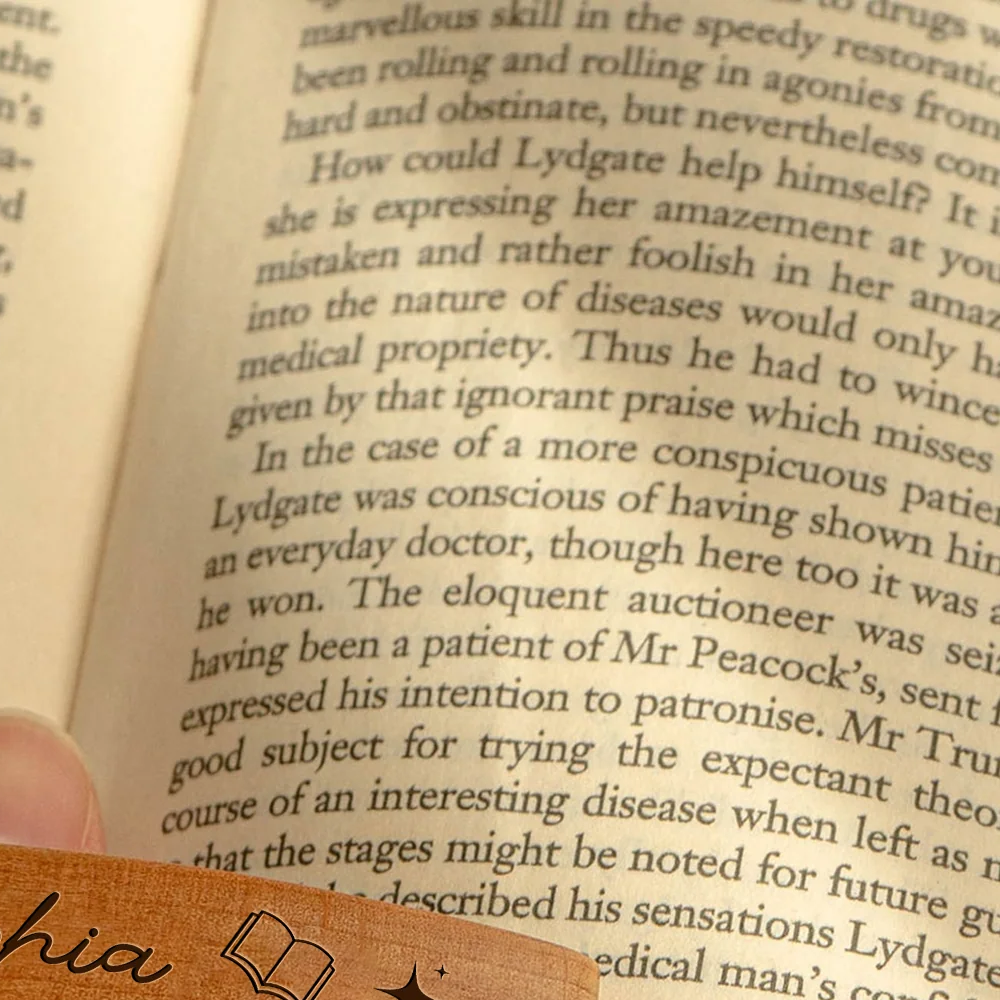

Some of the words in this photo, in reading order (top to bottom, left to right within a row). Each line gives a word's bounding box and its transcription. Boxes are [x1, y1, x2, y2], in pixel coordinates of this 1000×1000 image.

[298, 1, 480, 50] marvellous
[490, 0, 566, 30] skill
[574, 0, 611, 31] in
[624, 0, 685, 36] the
[694, 15, 824, 61] speedy
[281, 100, 358, 144] hard
[363, 92, 429, 131] and
[436, 90, 609, 128] obstinate,
[622, 91, 686, 128] but
[694, 107, 924, 167] nevertheless
[264, 202, 318, 239] she
[331, 196, 358, 229] is
[371, 184, 559, 231] expressing
[572, 184, 638, 220] her
[652, 200, 873, 252] amazement
[887, 235, 926, 263] at
[245, 302, 312, 334] into
[324, 286, 379, 322] the
[390, 289, 508, 316] nature
[521, 278, 569, 313] of
[575, 279, 724, 323] diseases
[740, 303, 859, 344] would
[872, 326, 958, 373] only
[224, 396, 314, 441] given
[323, 381, 366, 425] by
[375, 376, 447, 414] that
[454, 376, 614, 420] ignorant
[620, 384, 736, 424] praise
[746, 395, 861, 443] which
[872, 423, 995, 474] misses
[210, 486, 343, 536] Lydgate
[353, 486, 418, 512] was
[426, 476, 607, 513] conscious
[616, 480, 666, 514] of
[666, 481, 800, 541] having
[807, 502, 933, 559] shown
[203, 552, 238, 581] an
[245, 526, 398, 574] everyday
[404, 522, 534, 564] doctor,
[549, 525, 684, 575] though
[695, 533, 784, 579] here
[795, 555, 860, 590] too
[869, 562, 902, 600] it
[910, 582, 979, 620] was
[195, 595, 232, 633] he
[246, 590, 325, 618] won.
[347, 573, 423, 610] The
[442, 572, 610, 619] eloquent
[626, 586, 836, 636] auctioneer
[854, 620, 925, 657] was
[179, 676, 329, 738] expressed
[336, 675, 389, 712] his
[398, 674, 570, 713] intention
[583, 686, 623, 716] to
[630, 692, 825, 739] patronise.
[836, 708, 906, 753] Mr
[160, 784, 259, 836] course
[267, 778, 312, 818] of
[313, 789, 355, 815] an
[366, 776, 572, 828] interesting
[581, 781, 718, 827] disease
[730, 797, 839, 845] when
[851, 813, 922, 862] left
[930, 844, 970, 874] as
[377, 878, 560, 923] described
[568, 876, 625, 926] his
[630, 901, 836, 950] sensations
[843, 918, 1000, 990] Lydgate
[594, 941, 707, 984] edical
